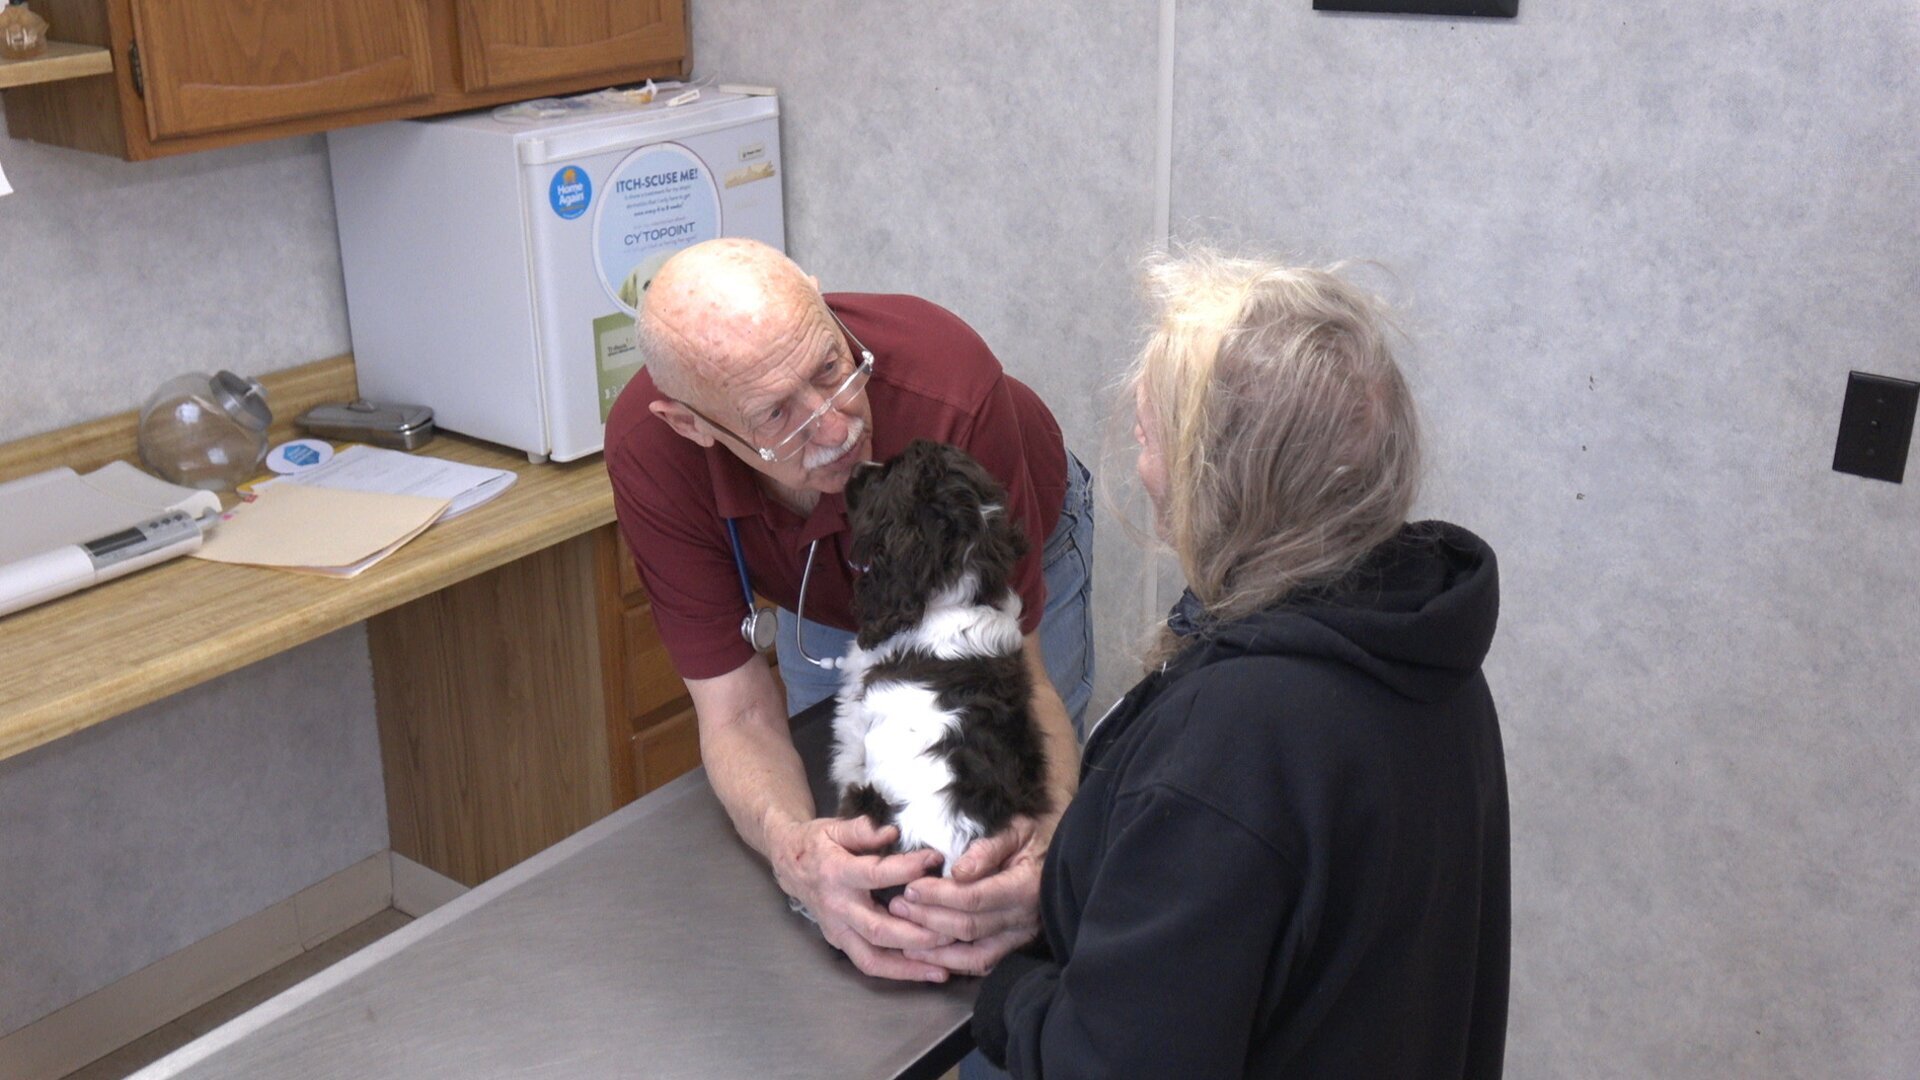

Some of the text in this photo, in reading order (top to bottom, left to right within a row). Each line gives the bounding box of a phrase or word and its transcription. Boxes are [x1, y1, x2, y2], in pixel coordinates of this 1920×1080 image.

[557, 182, 583, 196] Home
[616, 168, 698, 193] ITCH-SCUSE ME!
[559, 191, 584, 207] Again
[624, 221, 696, 246] CYTOPOINT
